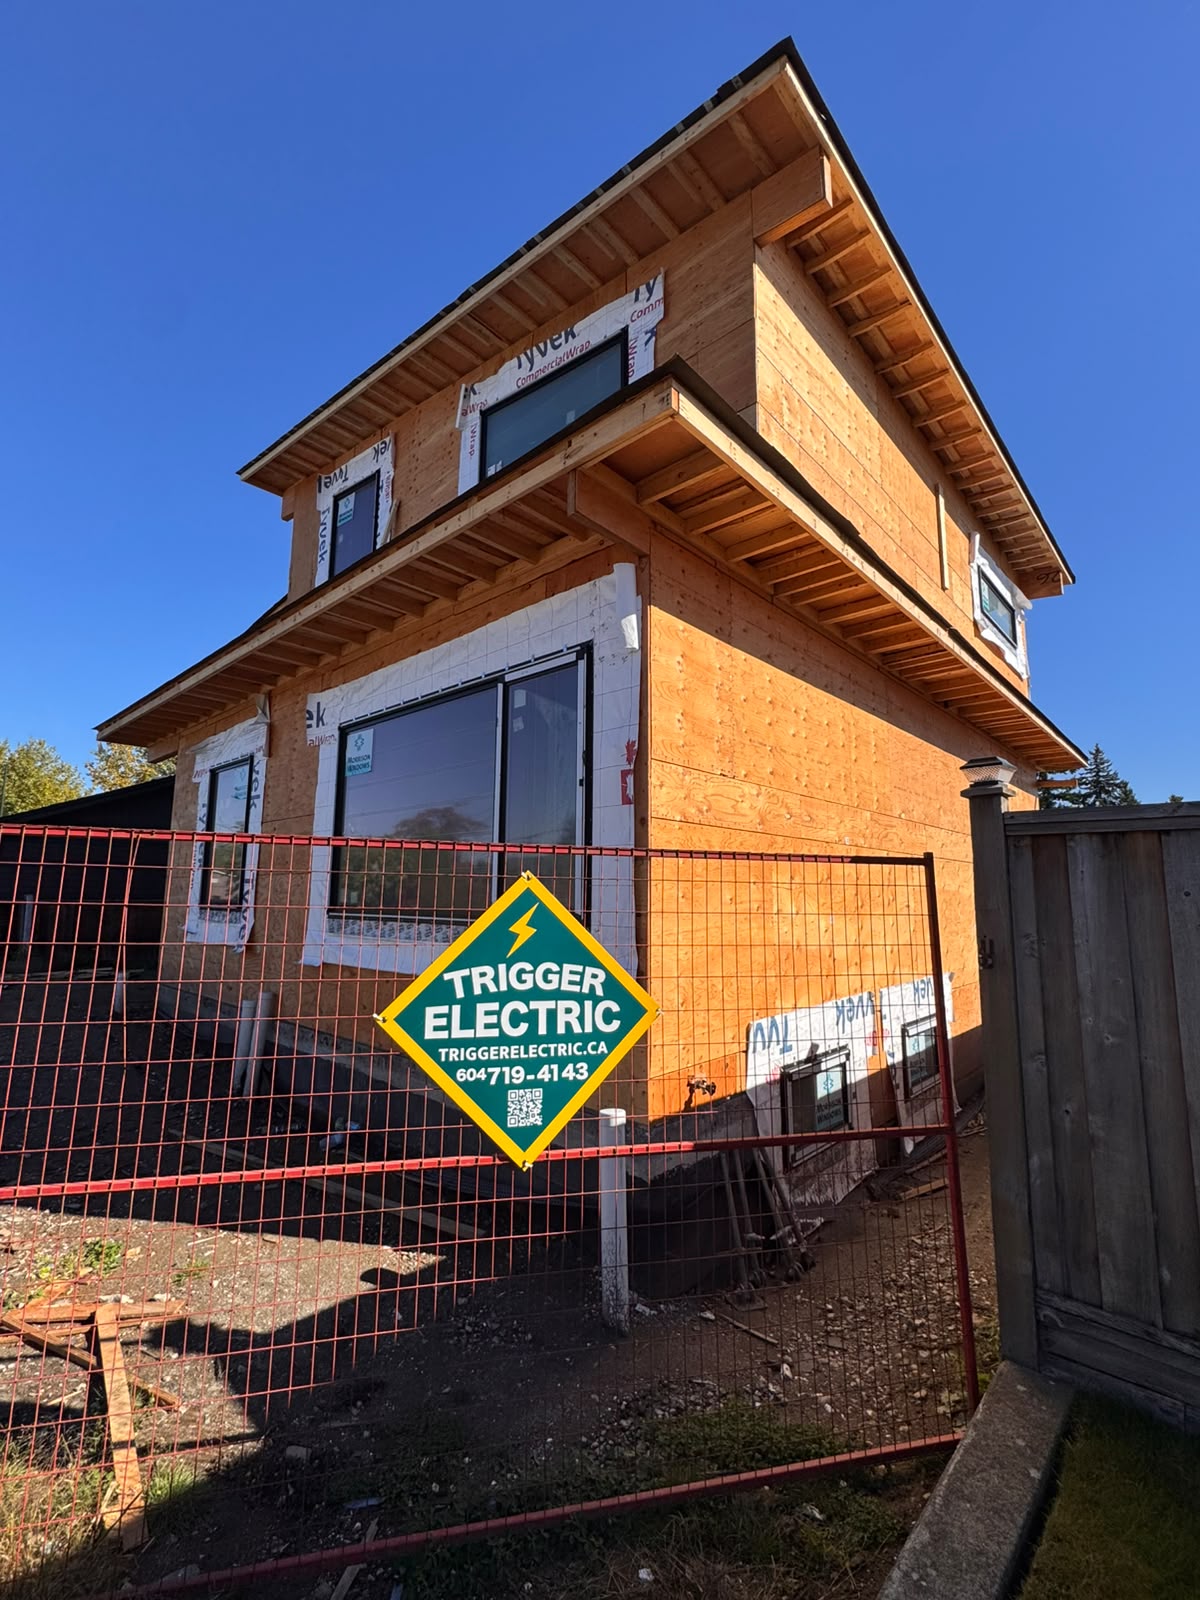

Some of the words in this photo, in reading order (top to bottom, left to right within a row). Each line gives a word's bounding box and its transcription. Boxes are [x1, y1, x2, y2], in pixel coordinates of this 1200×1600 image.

[515, 340, 591, 389] CommercialWrap
[443, 961, 607, 999] TRIGGER
[424, 1000, 621, 1040] ELECTRIC
[438, 1041, 608, 1062] TRIGGERELECTRIC.CA
